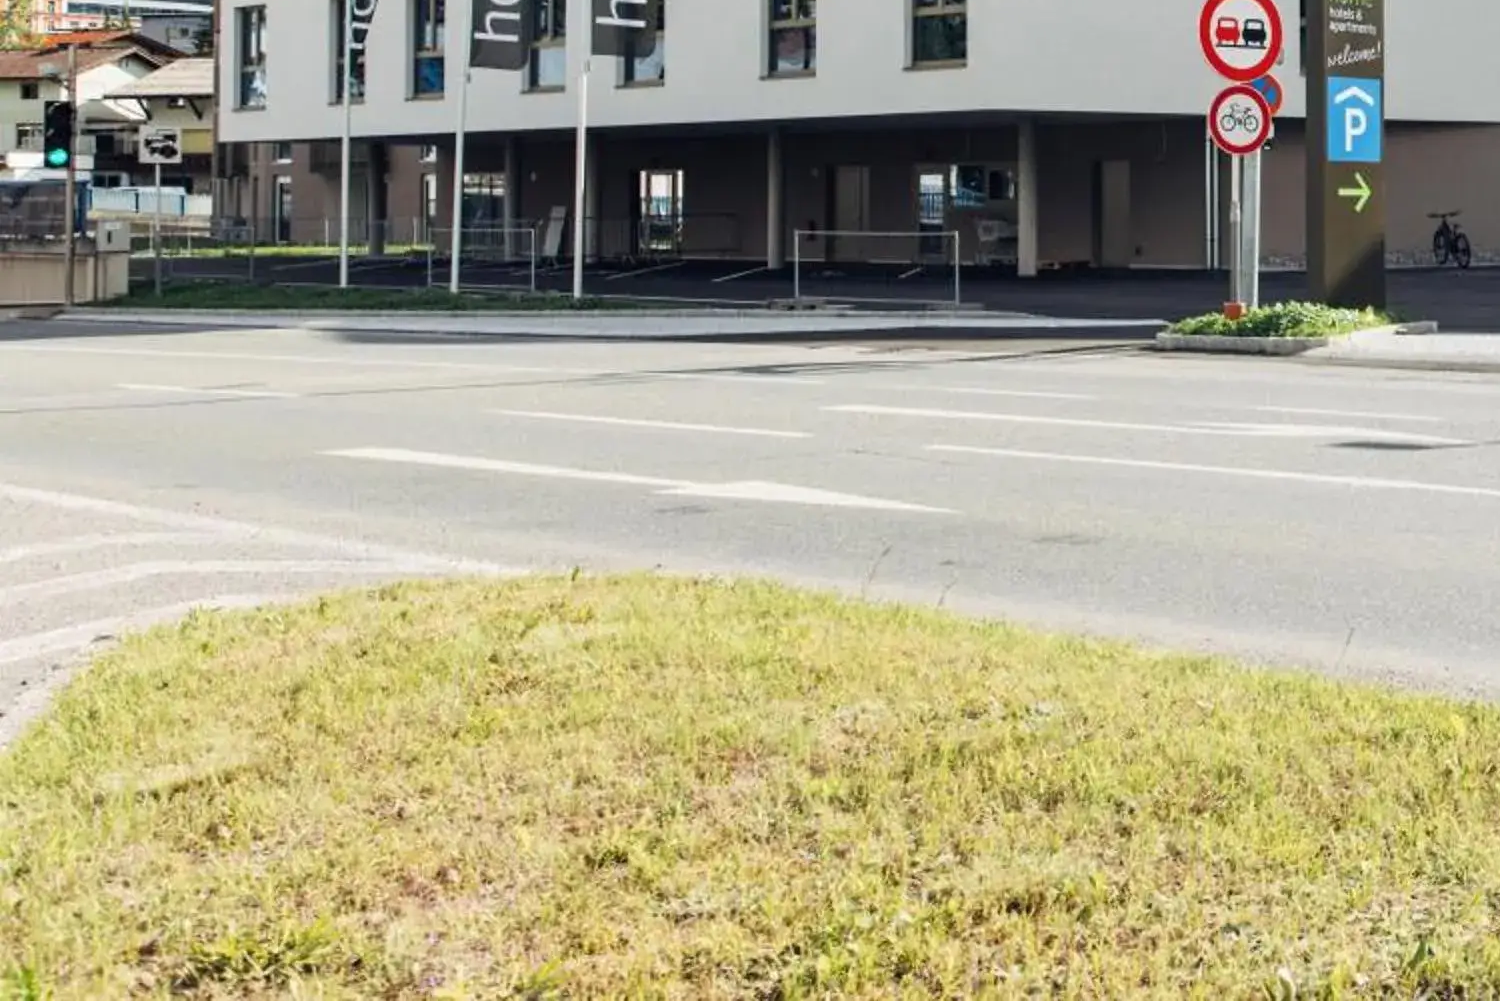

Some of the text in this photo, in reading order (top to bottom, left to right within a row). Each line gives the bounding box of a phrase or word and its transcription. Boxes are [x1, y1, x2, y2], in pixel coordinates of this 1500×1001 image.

[1329, 7, 1355, 20] hotels
[1329, 21, 1377, 36] apartments
[1328, 42, 1382, 67] welcome!
[1345, 108, 1368, 151] P
